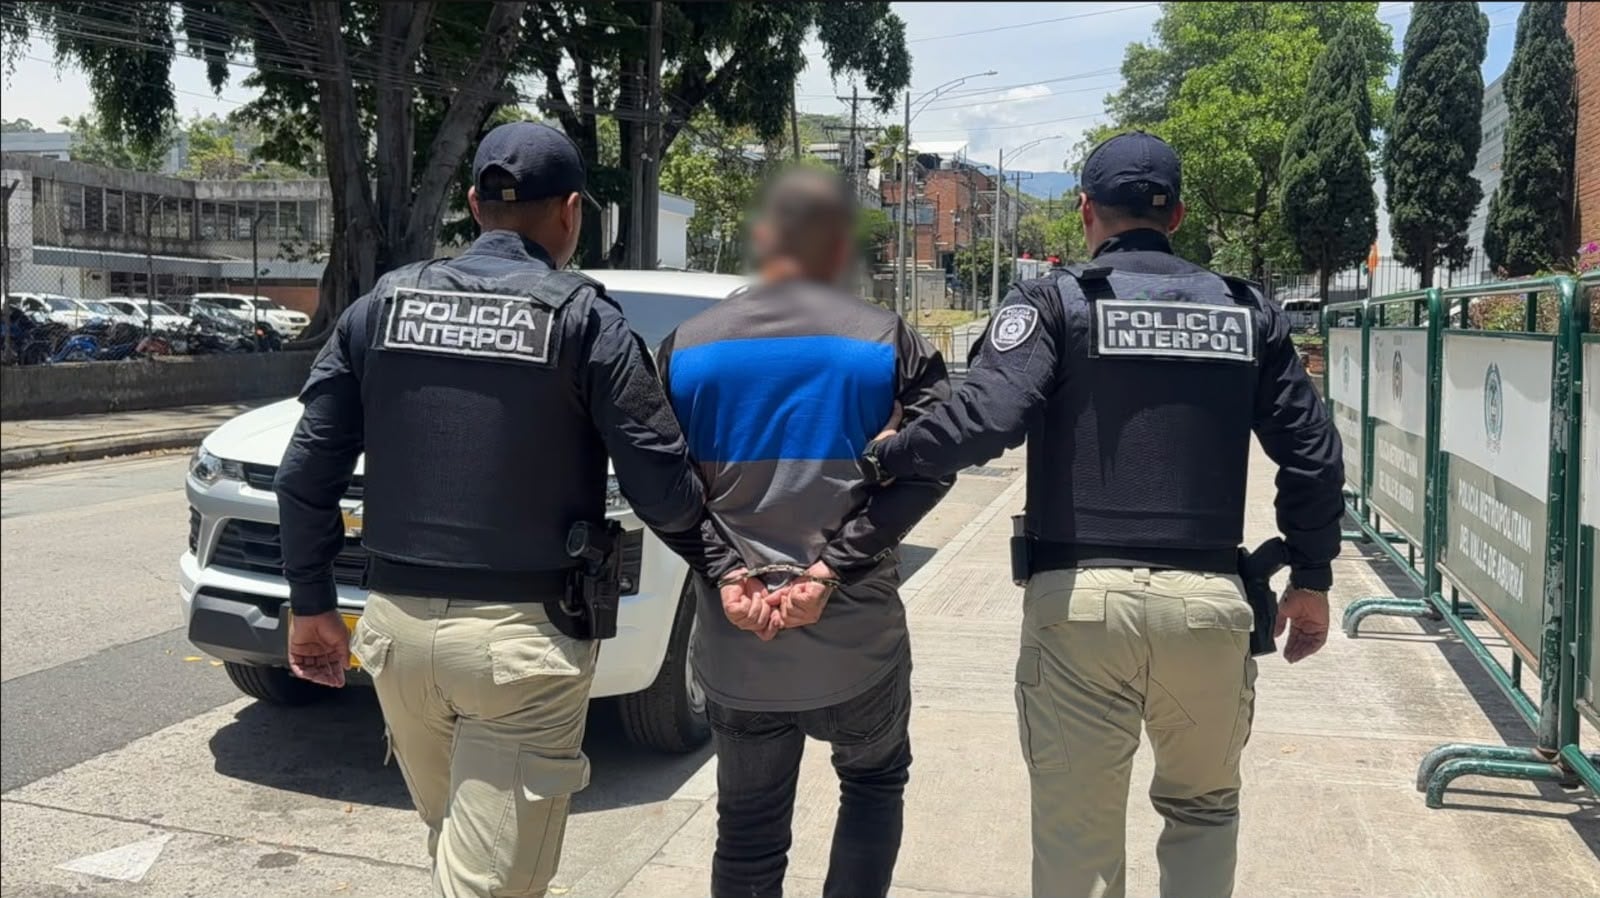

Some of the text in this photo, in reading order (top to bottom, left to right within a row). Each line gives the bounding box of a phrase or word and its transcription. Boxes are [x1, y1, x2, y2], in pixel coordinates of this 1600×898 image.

[400, 300, 536, 330] POLICÍA
[1107, 309, 1242, 334] POLICÍA
[397, 320, 534, 353] INTERPOL
[1108, 329, 1245, 353] INTERPOL
[1480, 490, 1532, 555] METROPOLITANA
[1470, 529, 1488, 573] VALLE
[1487, 544, 1497, 580] DE
